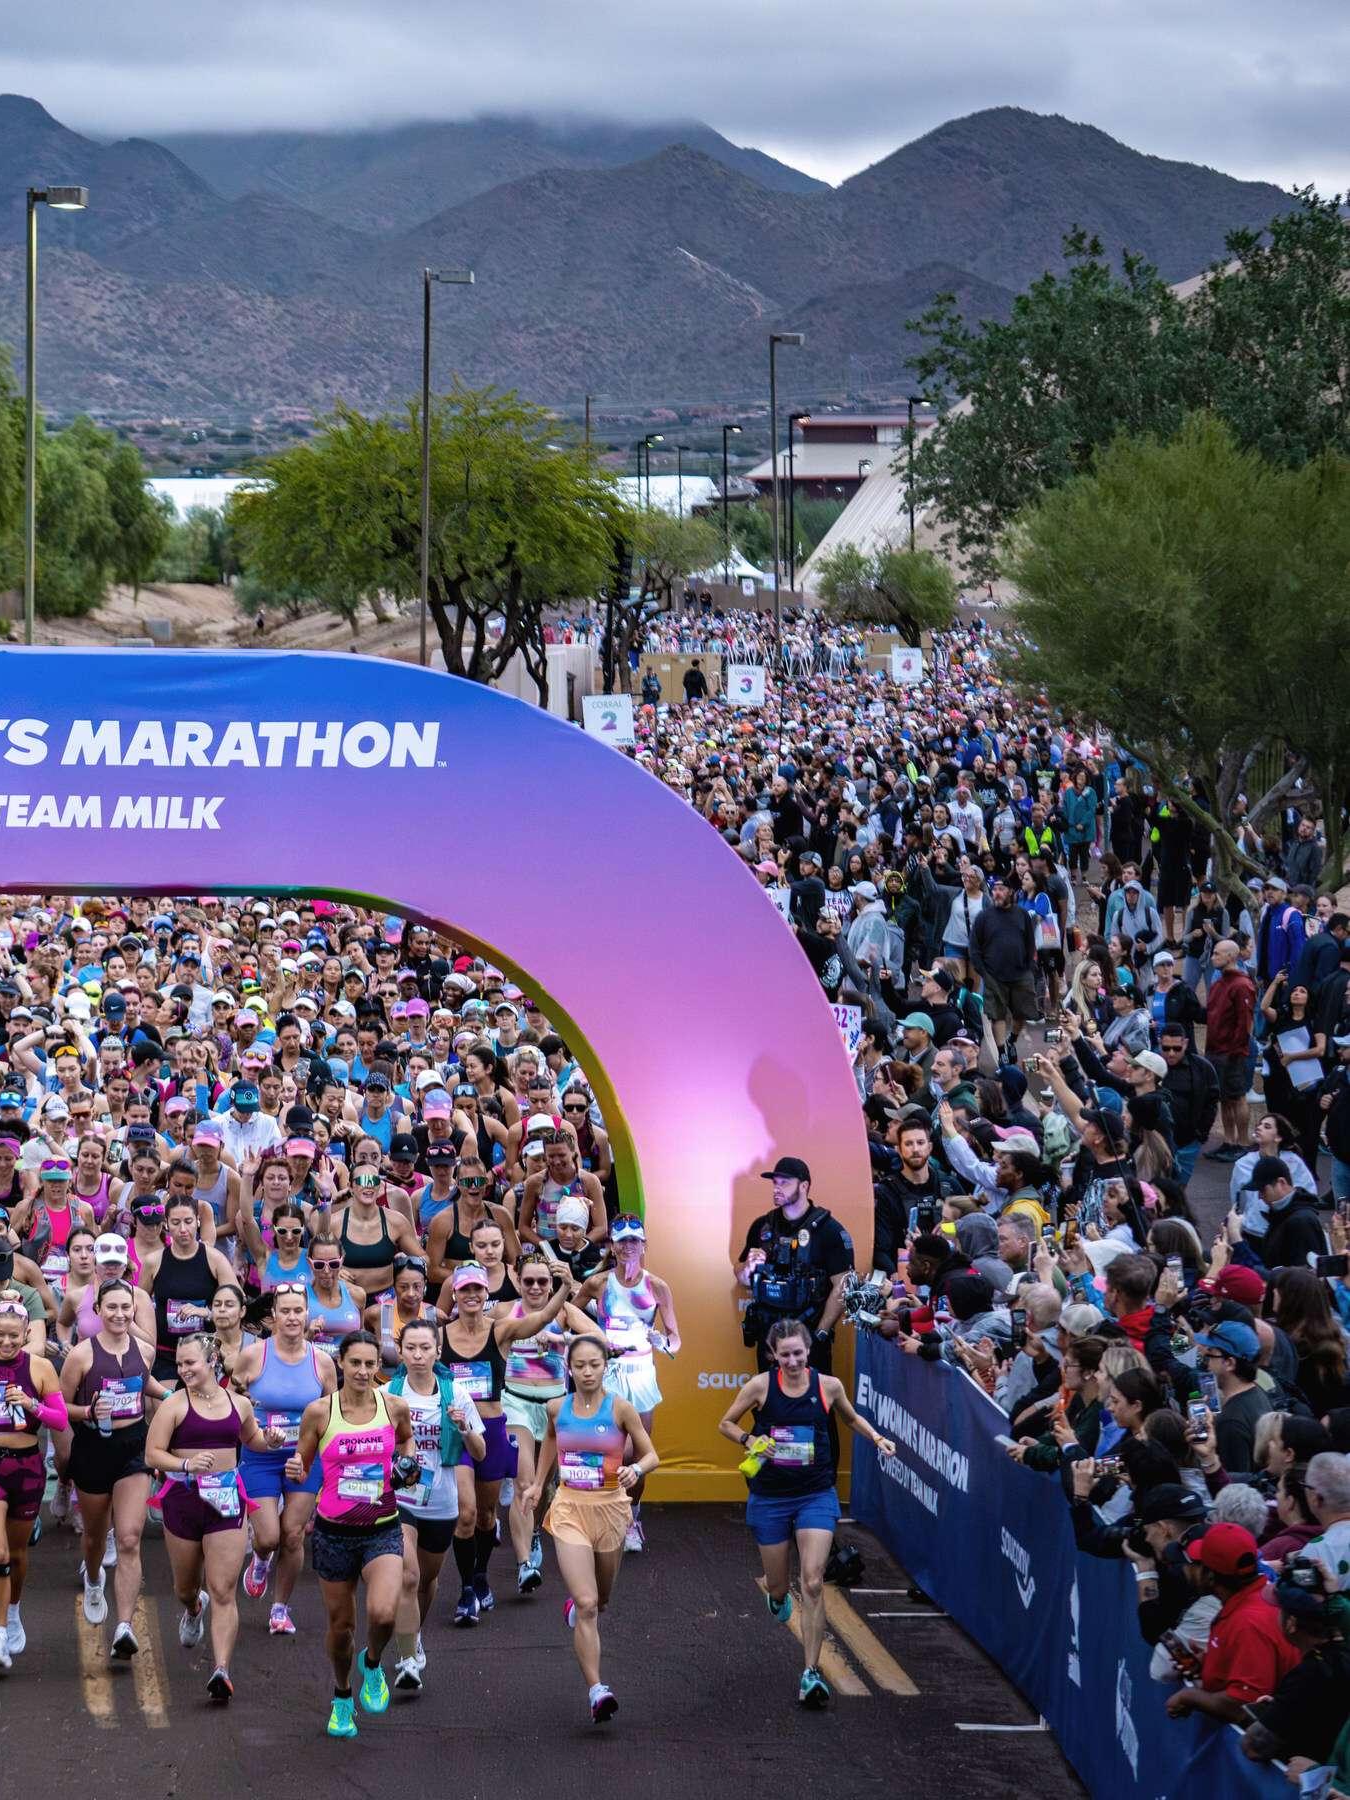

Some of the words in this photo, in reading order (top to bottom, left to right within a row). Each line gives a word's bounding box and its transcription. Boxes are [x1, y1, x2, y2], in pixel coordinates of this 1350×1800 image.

[901, 658, 913, 672] 4
[734, 668, 758, 677] CORRAL
[739, 677, 753, 694] 3
[591, 701, 623, 709] CORRAL
[600, 710, 618, 731] 2
[60, 720, 439, 769] MARATHON
[109, 796, 225, 830] MILK
[826, 898, 849, 906] TEAM
[697, 1372, 757, 1388] sauc
[419, 1425, 441, 1436] THE
[339, 1435, 383, 1446] SPOKANE
[338, 1442, 385, 1456] SWIFTS
[918, 1423, 969, 1494] MARATHON
[347, 1481, 369, 1492] 1913
